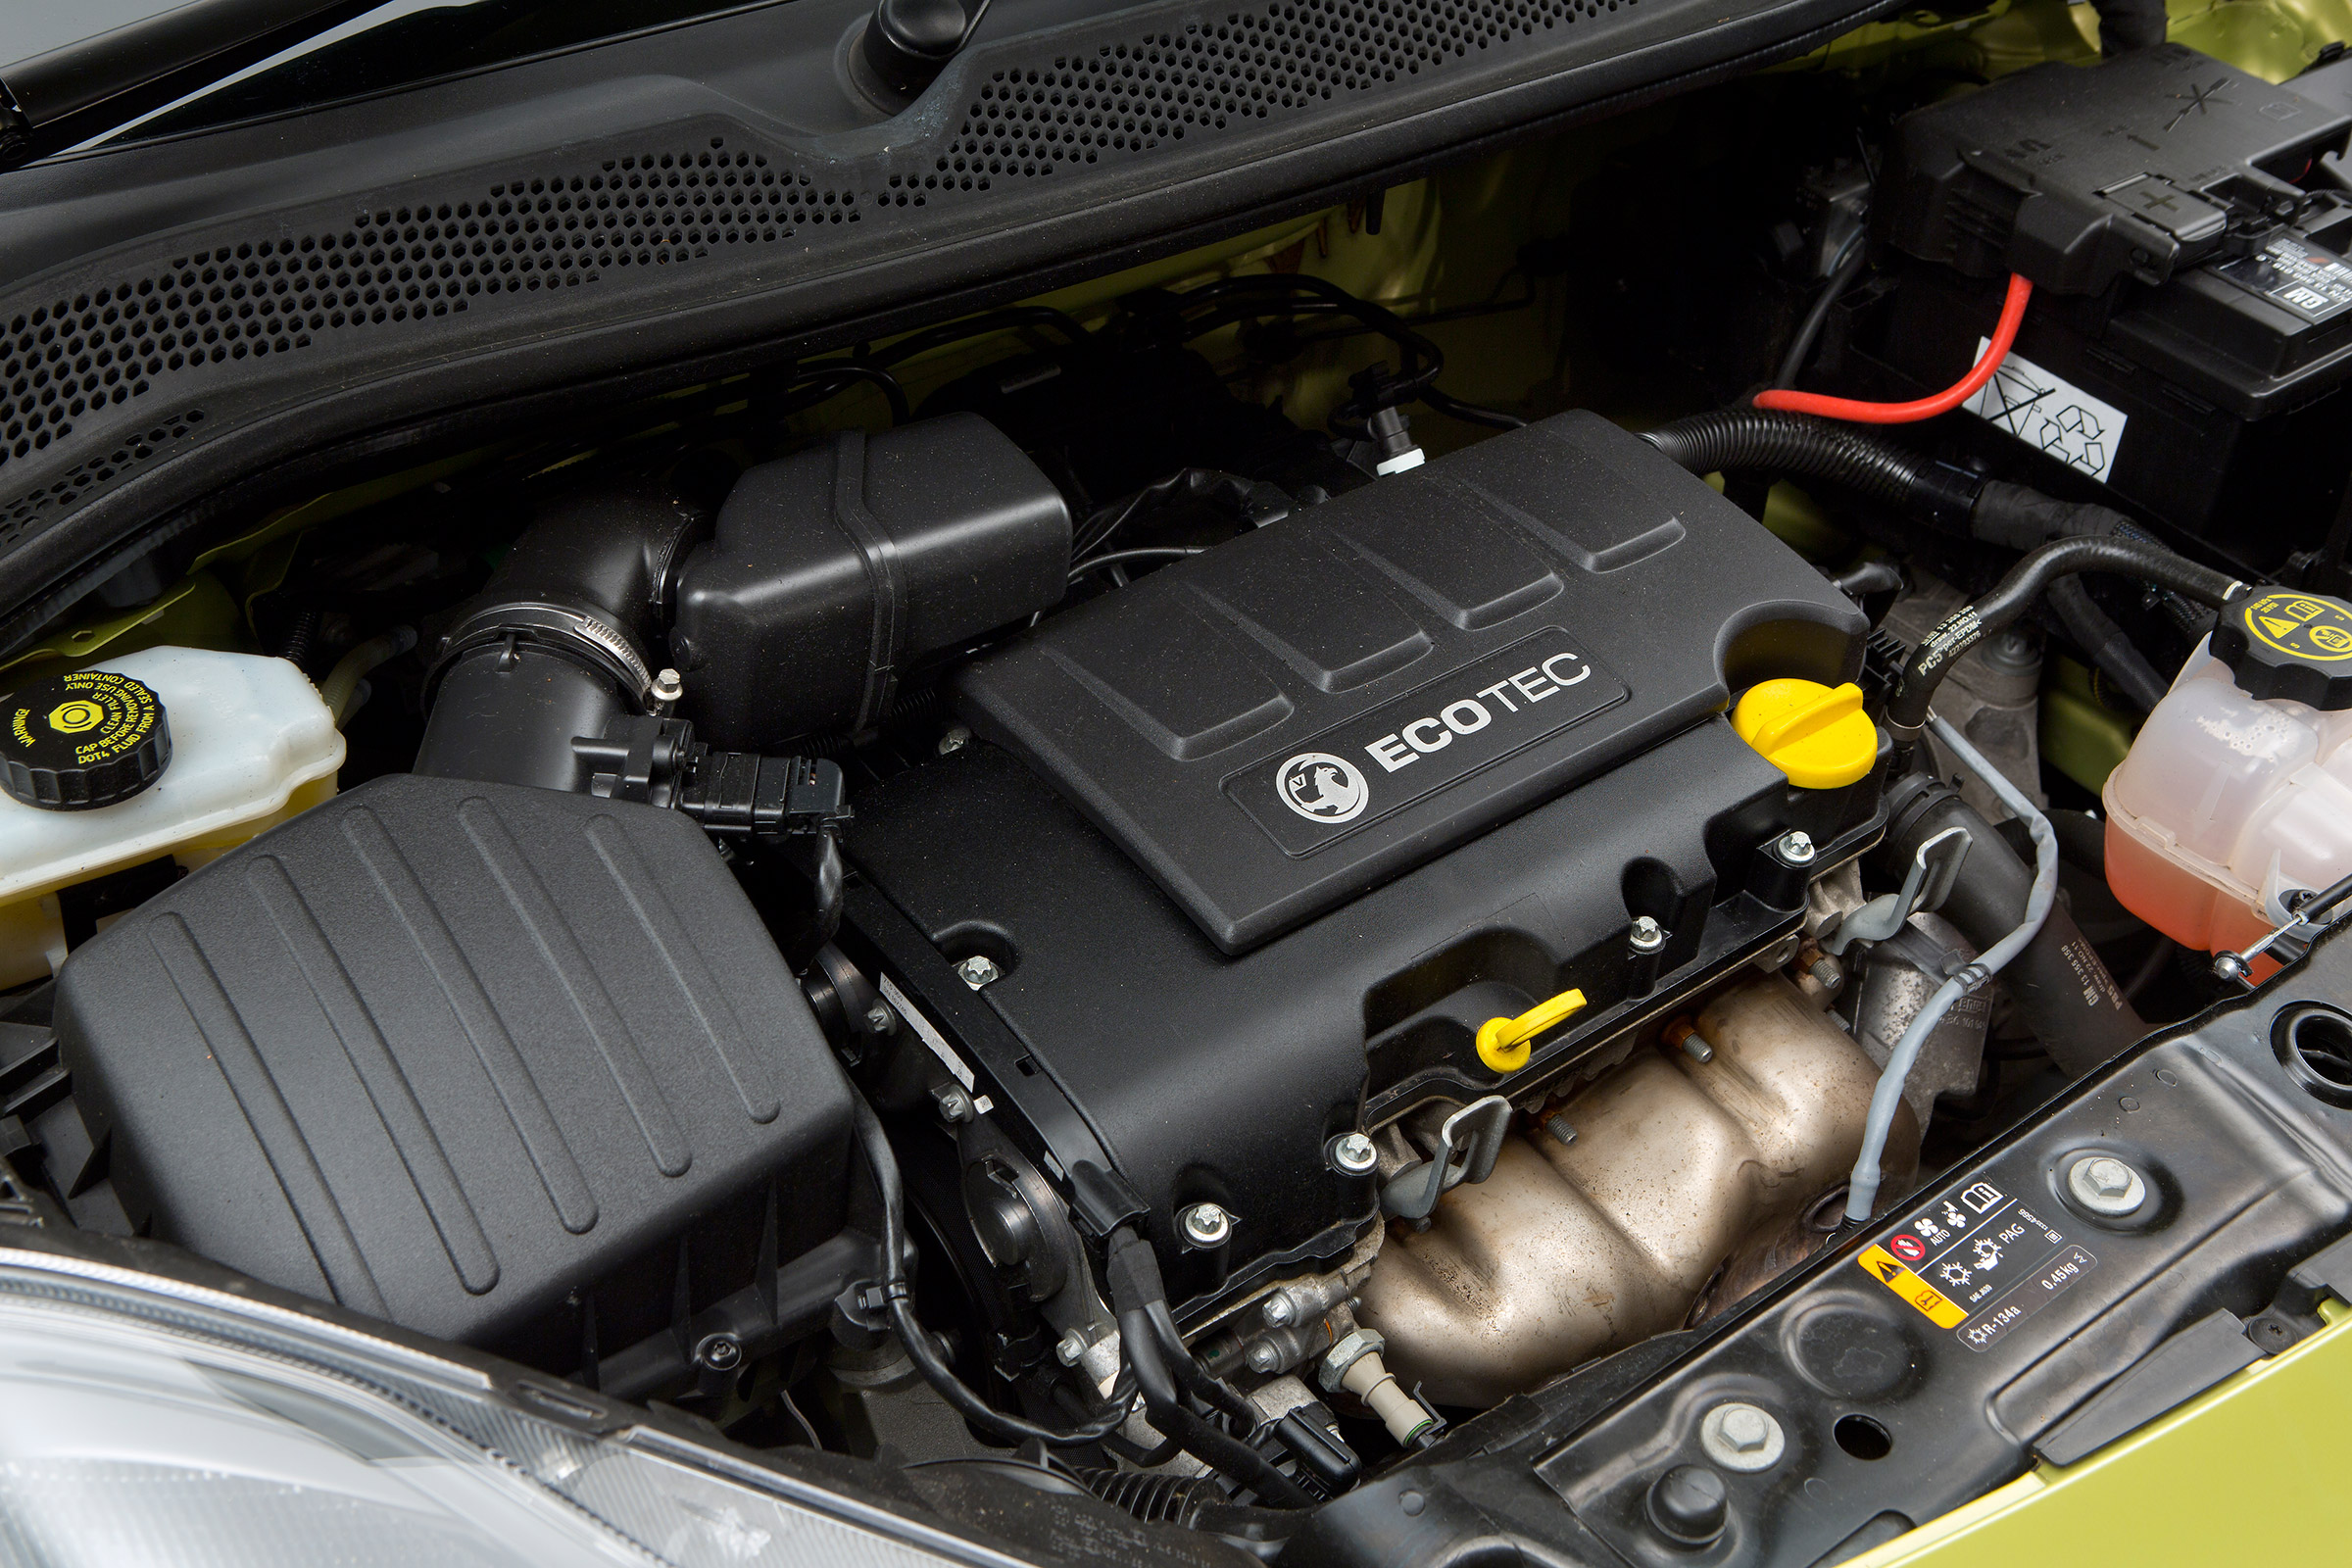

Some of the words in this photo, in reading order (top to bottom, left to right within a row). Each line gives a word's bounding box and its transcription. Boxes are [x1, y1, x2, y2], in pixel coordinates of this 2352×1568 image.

[2283, 286, 2328, 310] GM
[1918, 648, 1943, 676] PC5
[63, 672, 124, 685] CONTAINER
[65, 681, 94, 691] ONLY
[95, 682, 117, 694] USE
[92, 692, 122, 710] FILLER
[123, 681, 153, 705] SEALED
[113, 688, 139, 722] REMOVING
[1363, 652, 1592, 773] ECOTEC
[12, 708, 36, 748] WARNING!
[100, 711, 122, 734] CLEAN
[135, 712, 155, 734] FROM
[98, 723, 135, 748] BEFORE
[111, 733, 141, 754] FLUID
[74, 743, 98, 755] CAP
[77, 751, 111, 764] DOT4
[2071, 959, 2083, 975] 355
[2081, 974, 2089, 986] 13
[2083, 986, 2099, 1006] GM
[1930, 1229, 1951, 1247] AUTO
[1998, 1222, 2026, 1244] PAG
[1969, 1291, 1983, 1303] SAE
[1982, 1304, 2022, 1336] R-134a
[2041, 1261, 2080, 1291] 0.45kg
